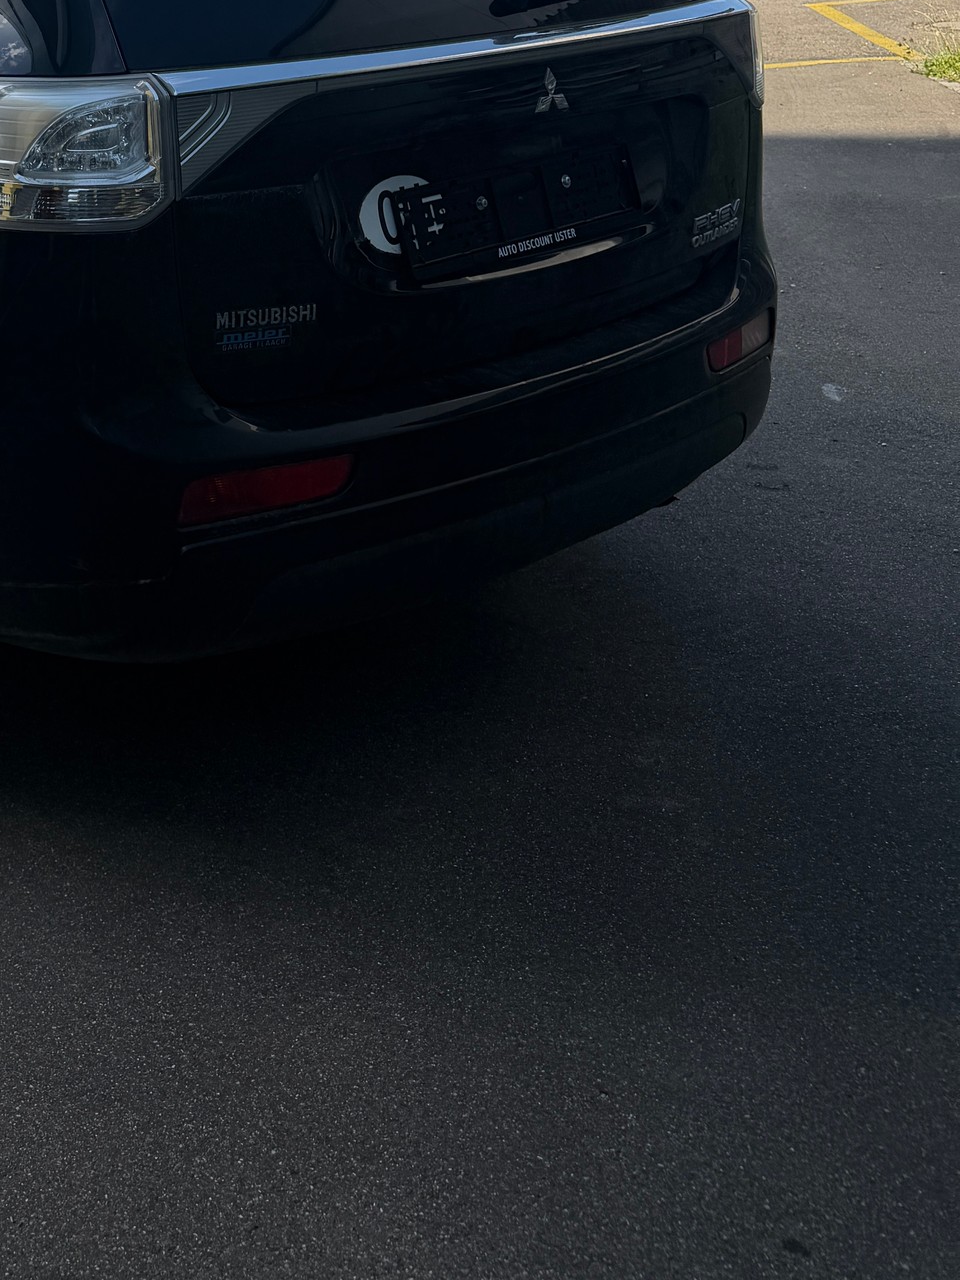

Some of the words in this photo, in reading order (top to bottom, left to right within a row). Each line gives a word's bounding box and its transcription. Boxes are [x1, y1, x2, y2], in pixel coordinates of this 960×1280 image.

[498, 243, 518, 258] AUTO
[518, 233, 554, 253] DISCOUNT
[554, 228, 577, 243] USTER
[691, 217, 739, 248] OUTLANDER
[216, 303, 317, 329] MITSUBISHI
